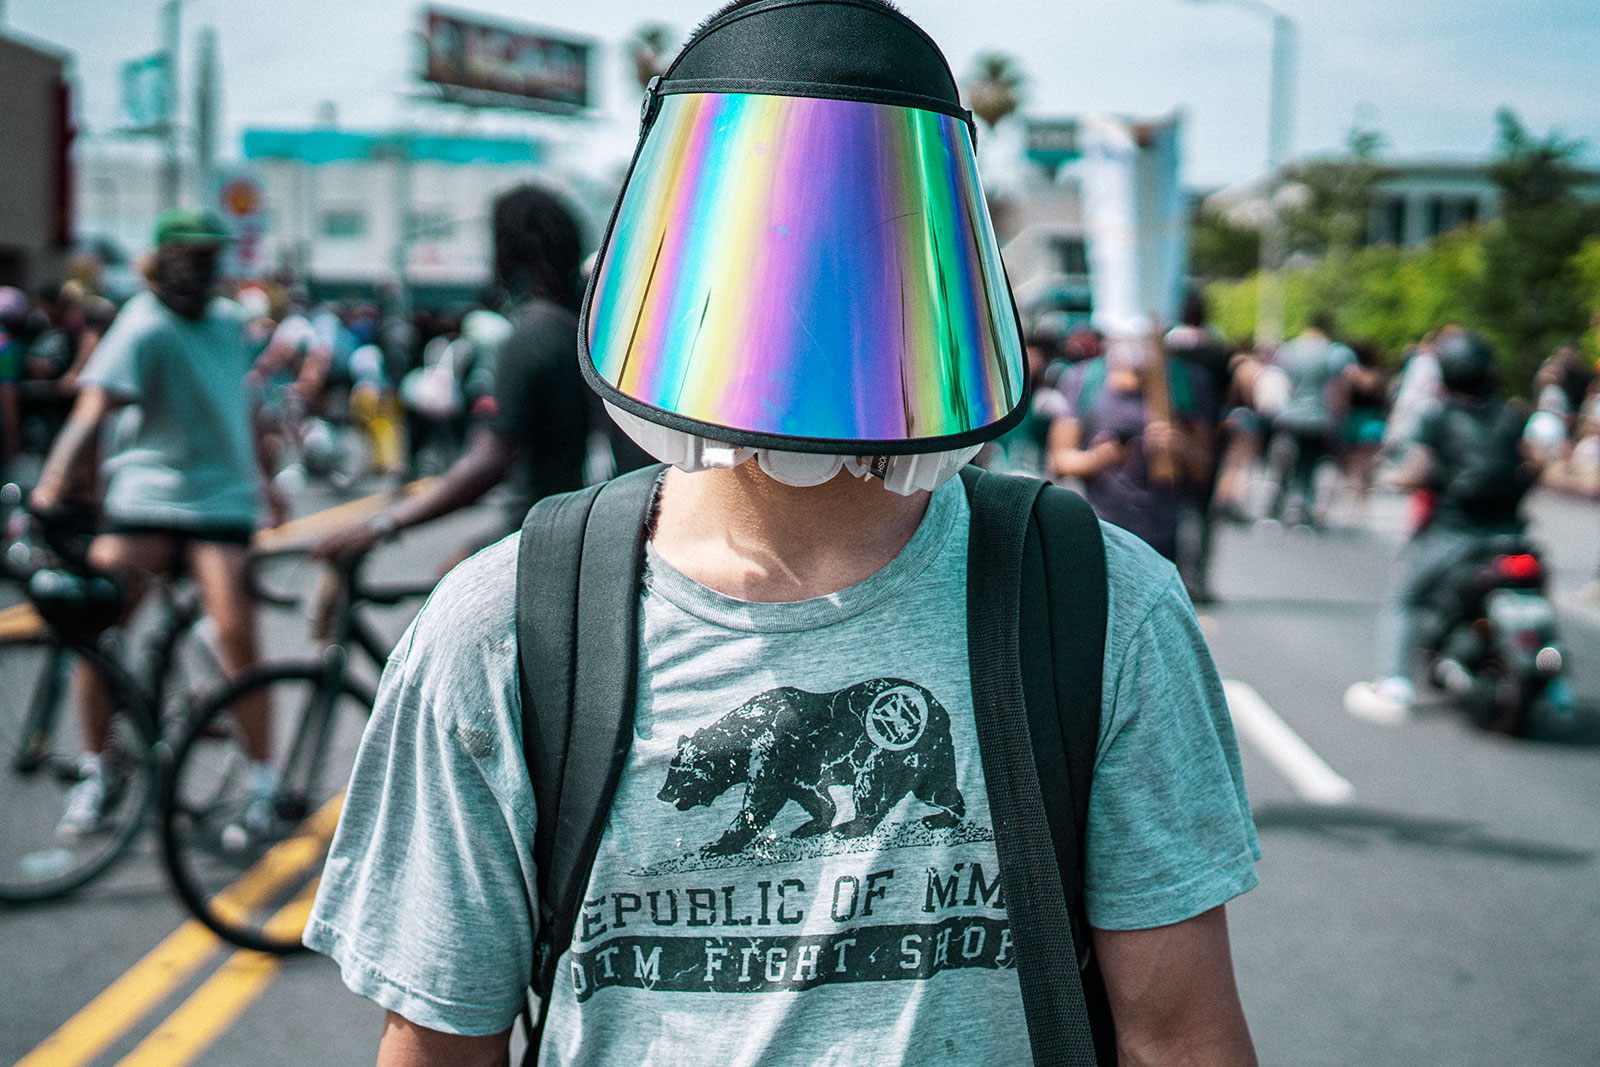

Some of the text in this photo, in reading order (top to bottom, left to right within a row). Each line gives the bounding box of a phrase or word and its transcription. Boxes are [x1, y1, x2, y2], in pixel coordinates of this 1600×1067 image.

[573, 878, 805, 942] EPUBLIC
[831, 869, 894, 922] OF
[703, 938, 857, 983] FIGHT
